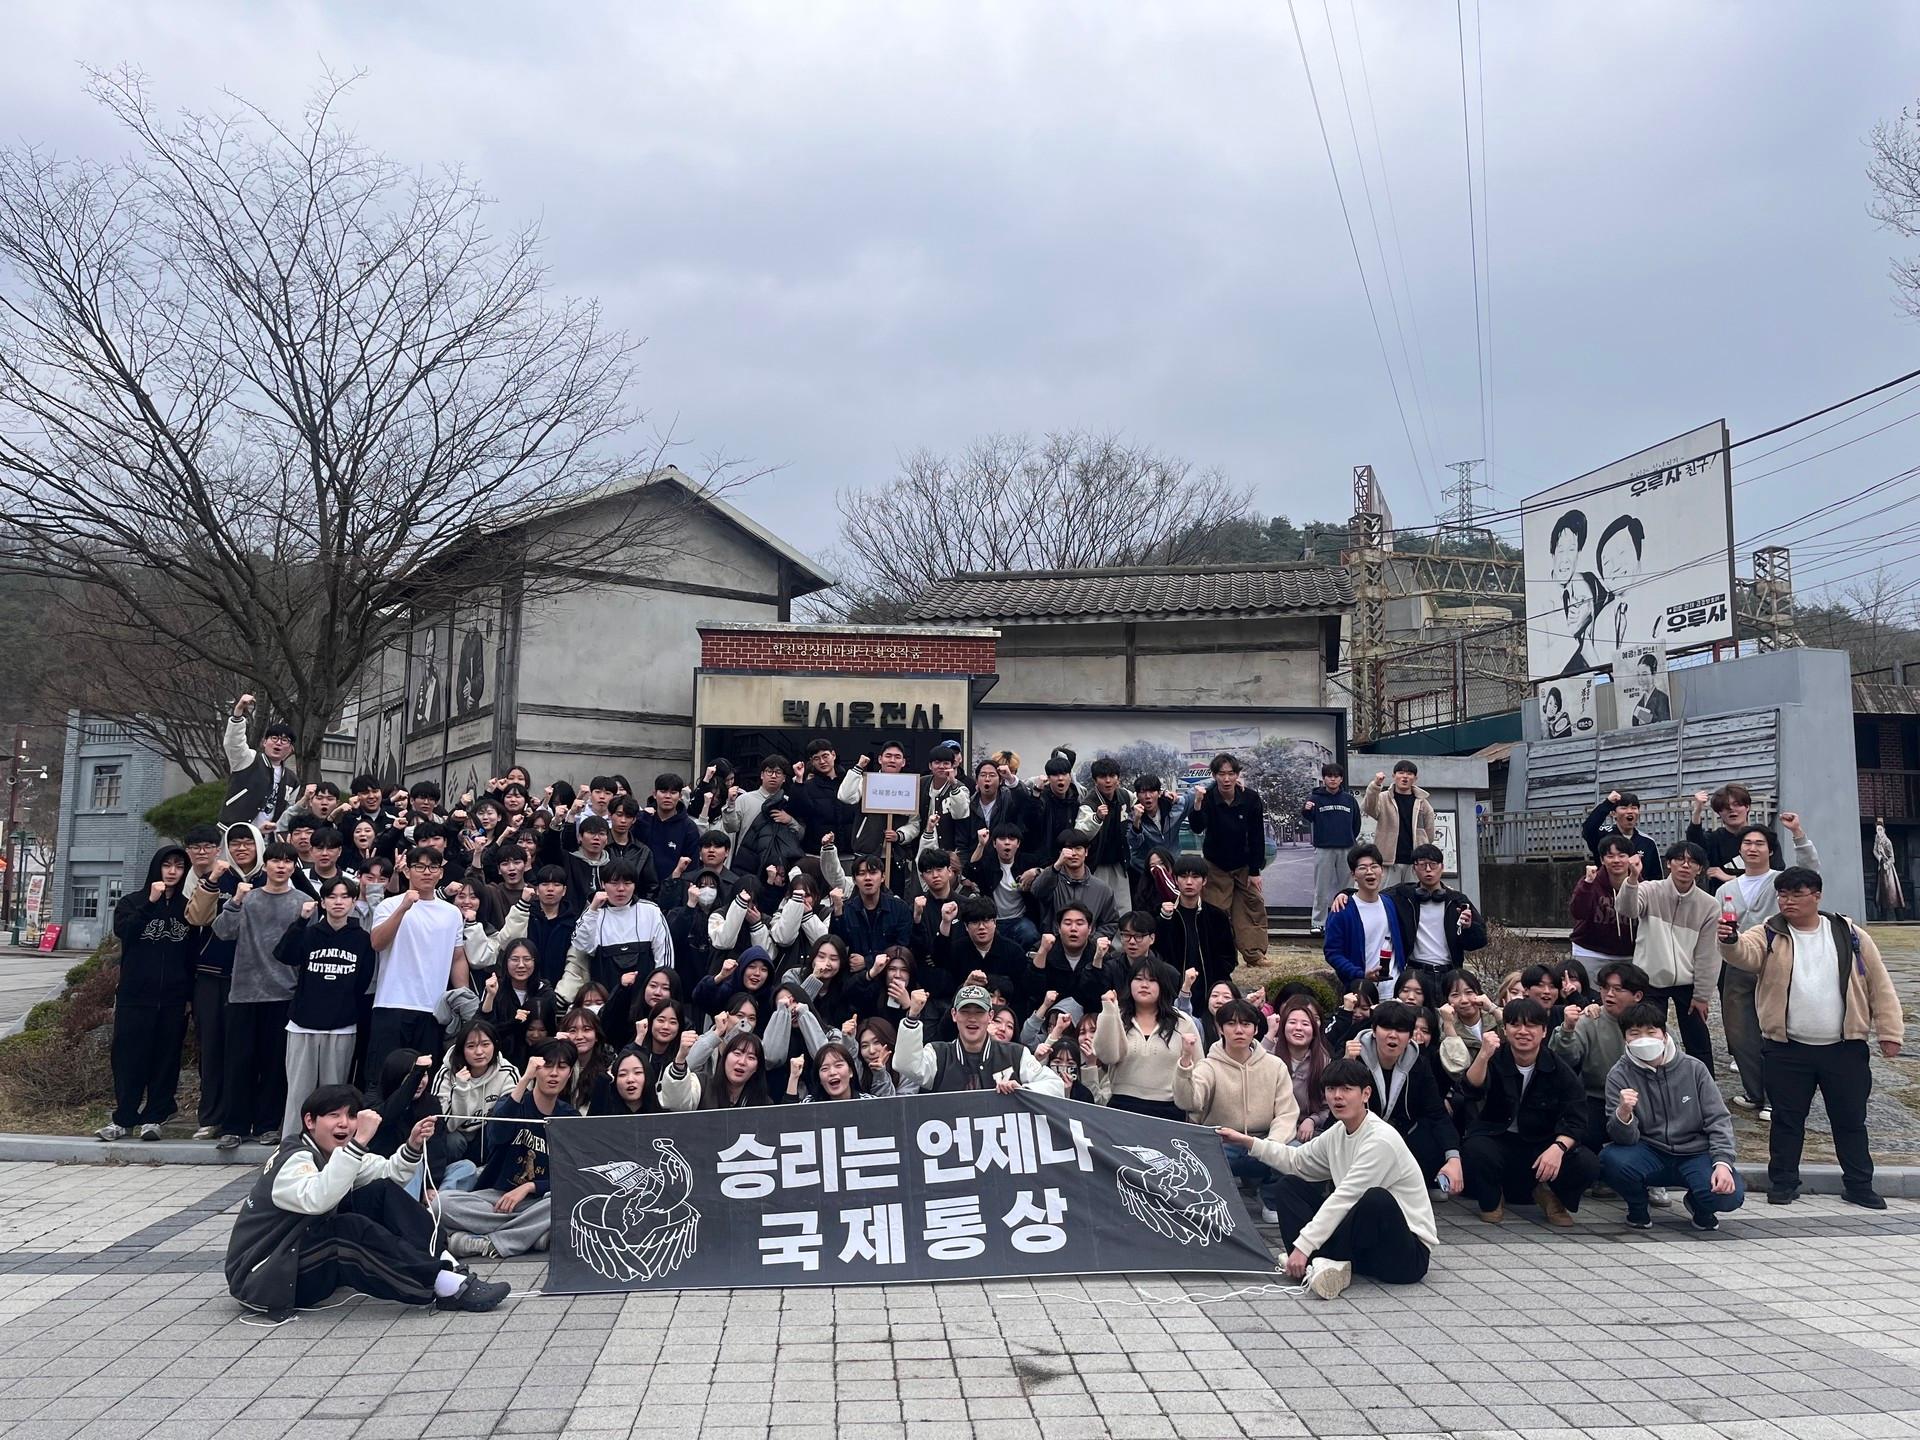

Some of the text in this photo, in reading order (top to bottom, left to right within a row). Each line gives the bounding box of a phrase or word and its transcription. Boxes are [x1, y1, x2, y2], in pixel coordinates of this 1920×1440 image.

[1630, 468, 1682, 497] 우루사
[1667, 603, 1727, 633] 우루사
[772, 644, 869, 657] 합천영상테마파크
[783, 700, 943, 729] 택시운전사
[309, 948, 358, 963] STANARD
[717, 1112, 1095, 1199] 승리는 언제나
[758, 1188, 1069, 1272] 국제통상
